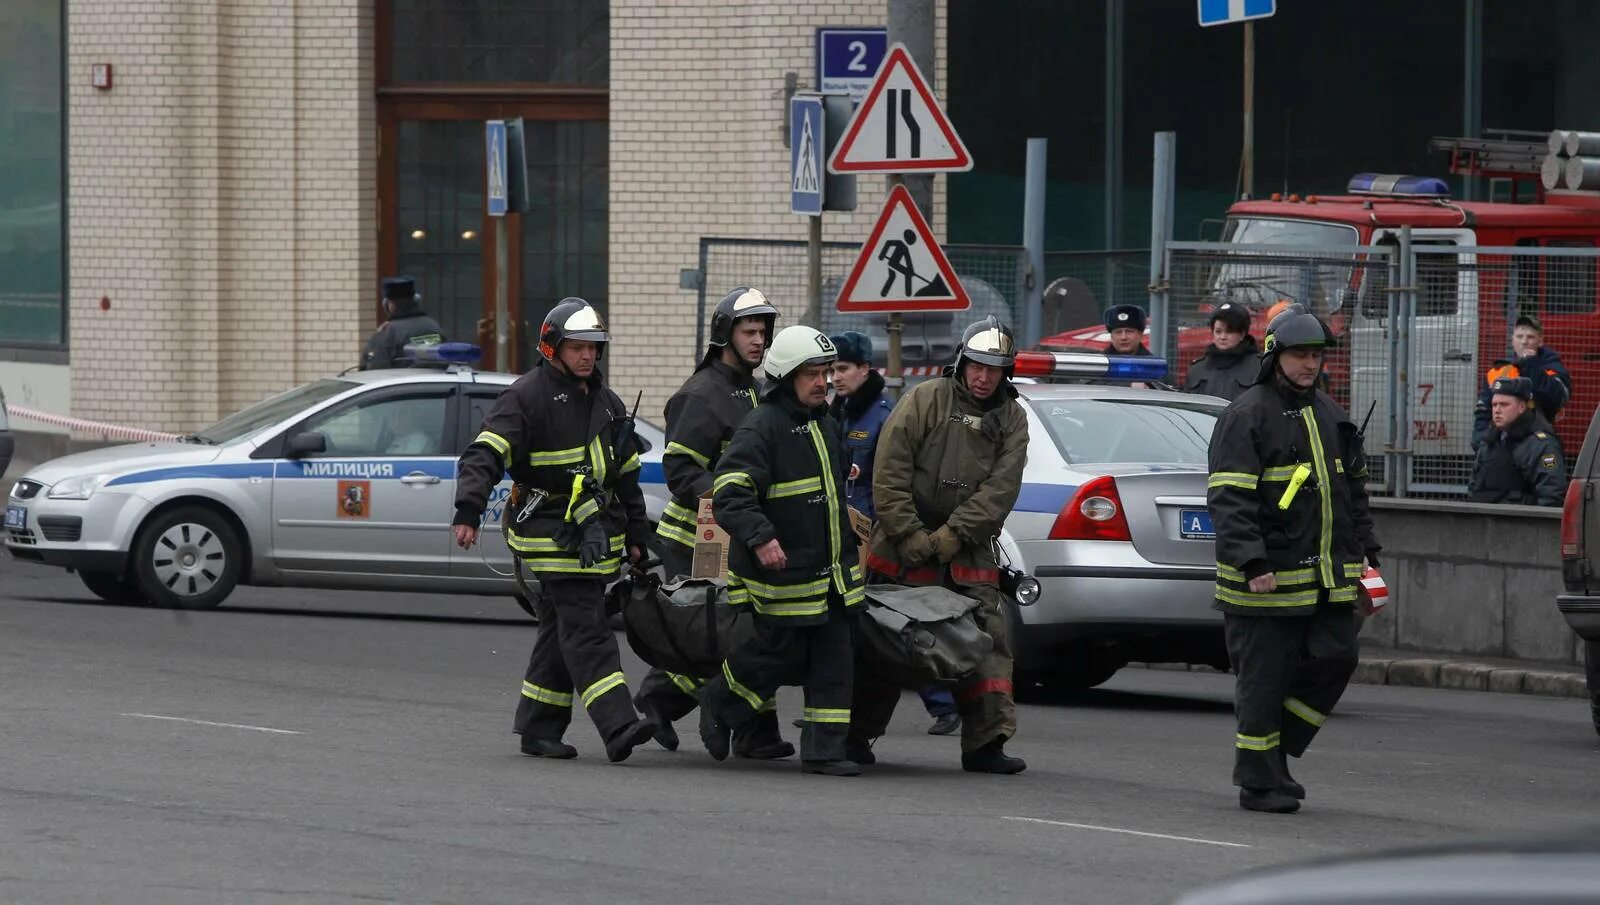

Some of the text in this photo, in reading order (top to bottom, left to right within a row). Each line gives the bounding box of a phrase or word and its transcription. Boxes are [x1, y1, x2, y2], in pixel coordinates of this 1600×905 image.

[848, 41, 867, 72] 2
[1417, 384, 1434, 405] 7
[302, 462, 394, 477] МИЛИЦИЯ
[1191, 516, 1202, 531] А
